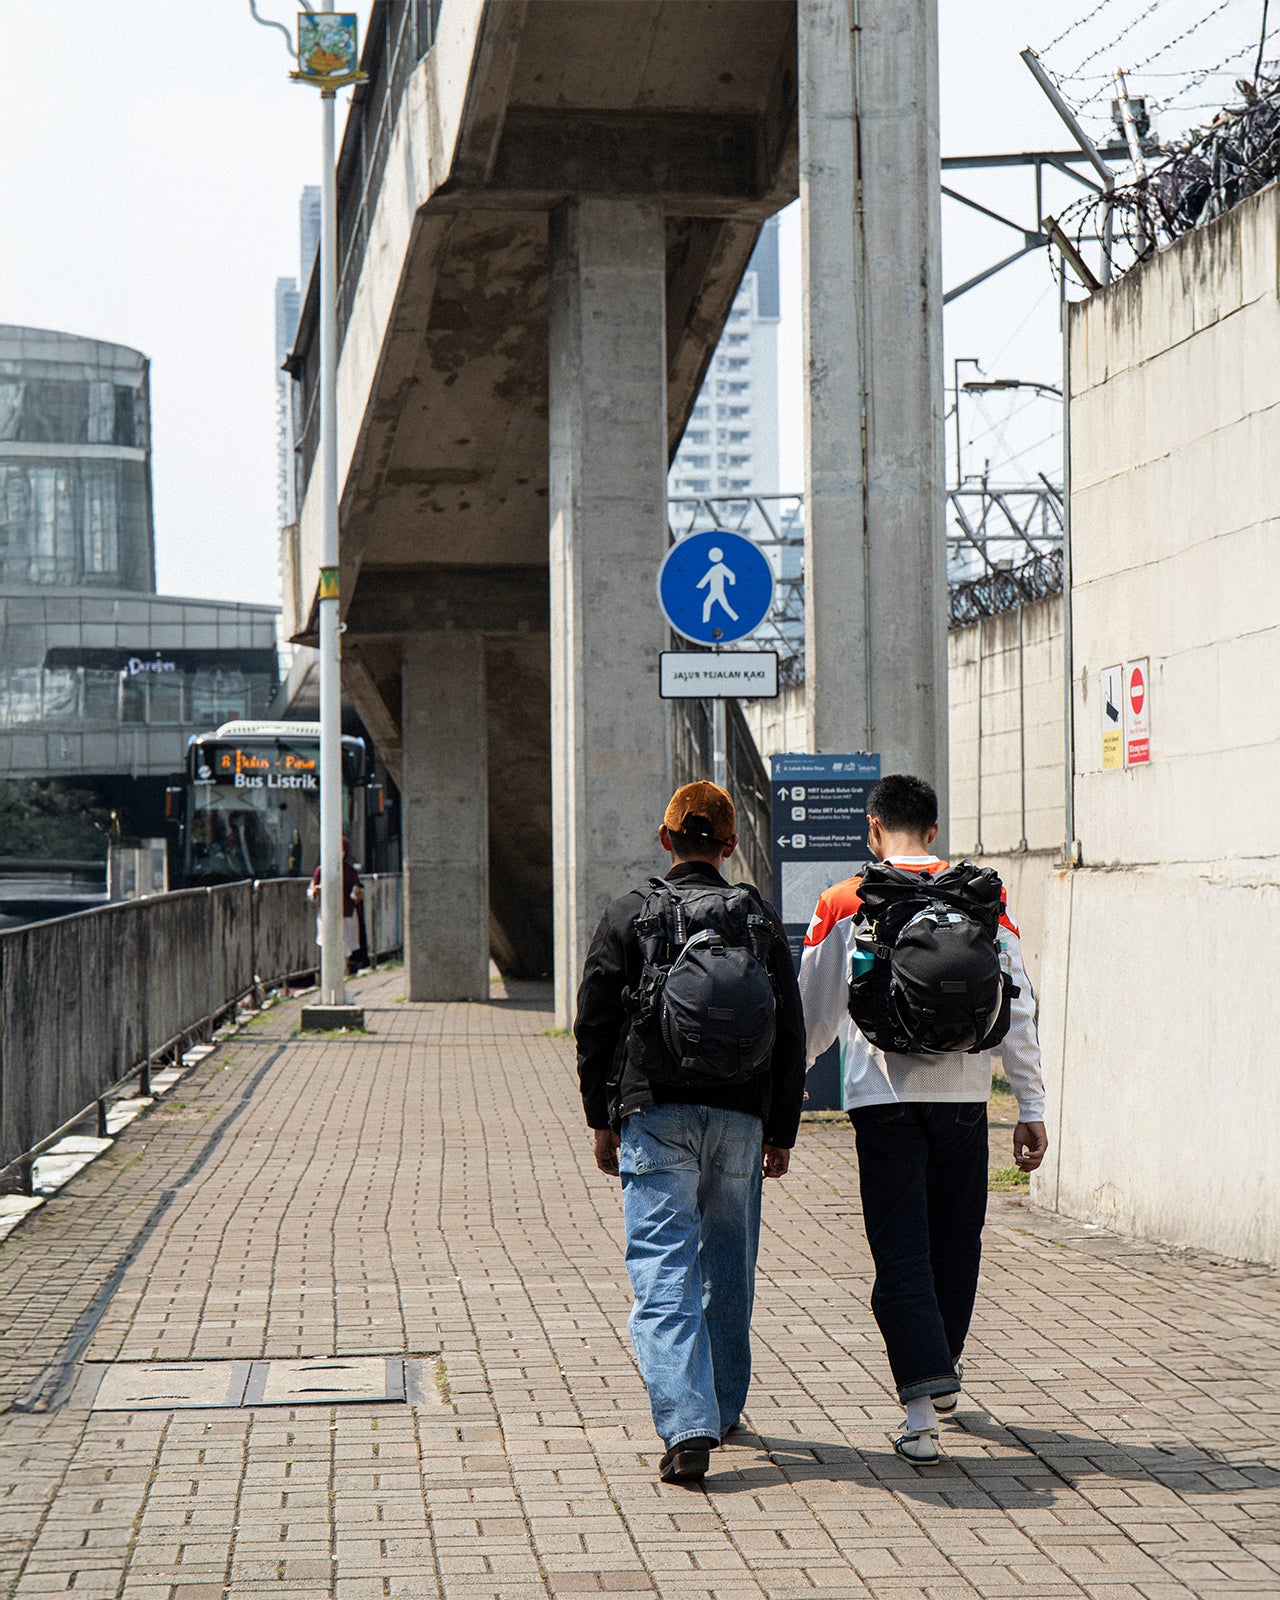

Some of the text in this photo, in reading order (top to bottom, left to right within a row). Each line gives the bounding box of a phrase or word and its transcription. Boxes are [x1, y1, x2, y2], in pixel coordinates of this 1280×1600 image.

[743, 671, 765, 681] KAKI
[234, 773, 317, 789] Bus Listrik
